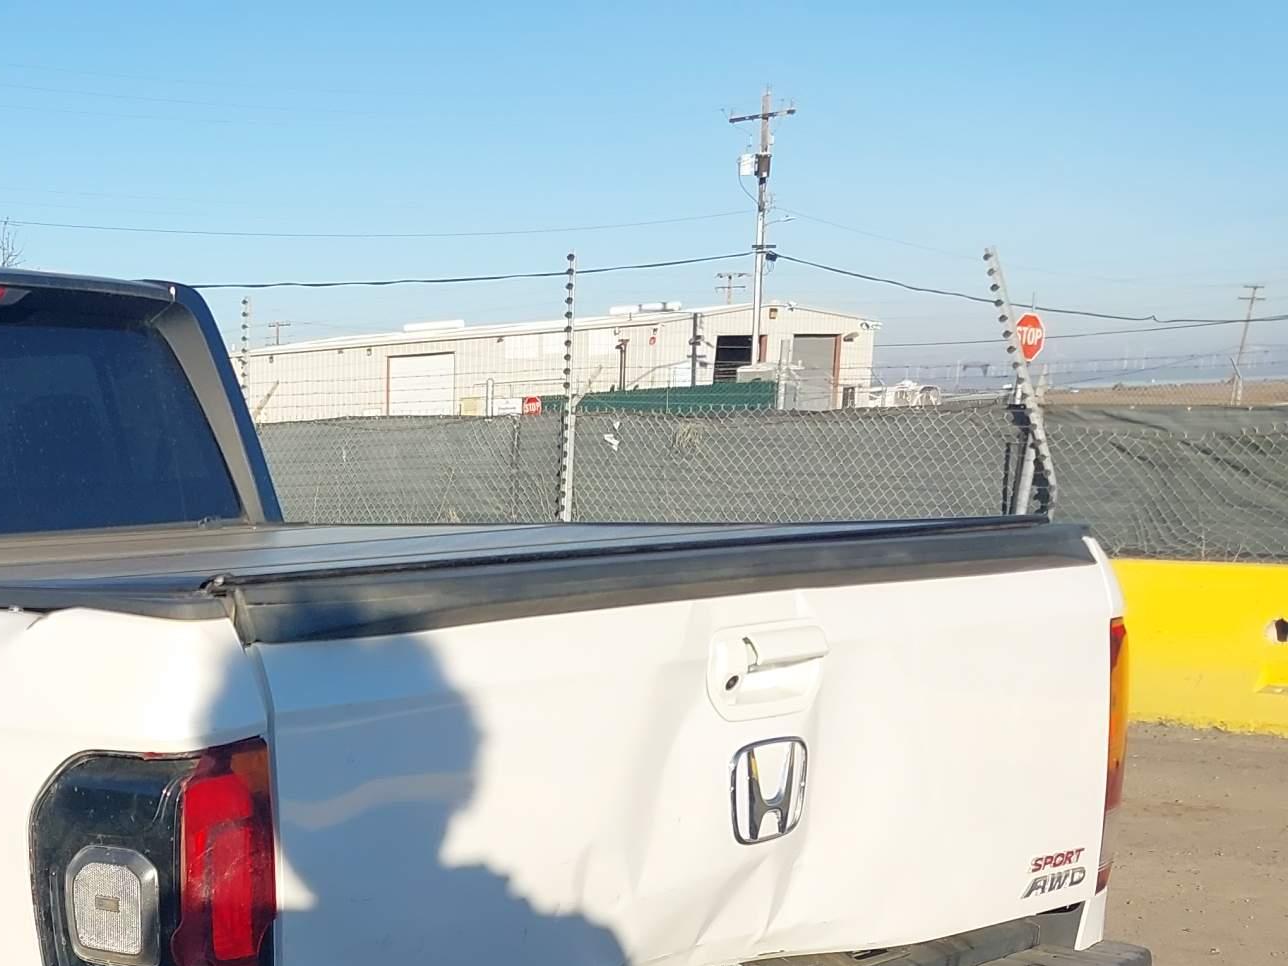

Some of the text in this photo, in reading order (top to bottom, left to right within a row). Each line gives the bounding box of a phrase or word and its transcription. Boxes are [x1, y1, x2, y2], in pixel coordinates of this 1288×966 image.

[1016, 326, 1043, 345] STOP
[524, 402, 540, 412] STOP
[1030, 847, 1085, 873] SPORT
[1020, 866, 1086, 899] AWD
